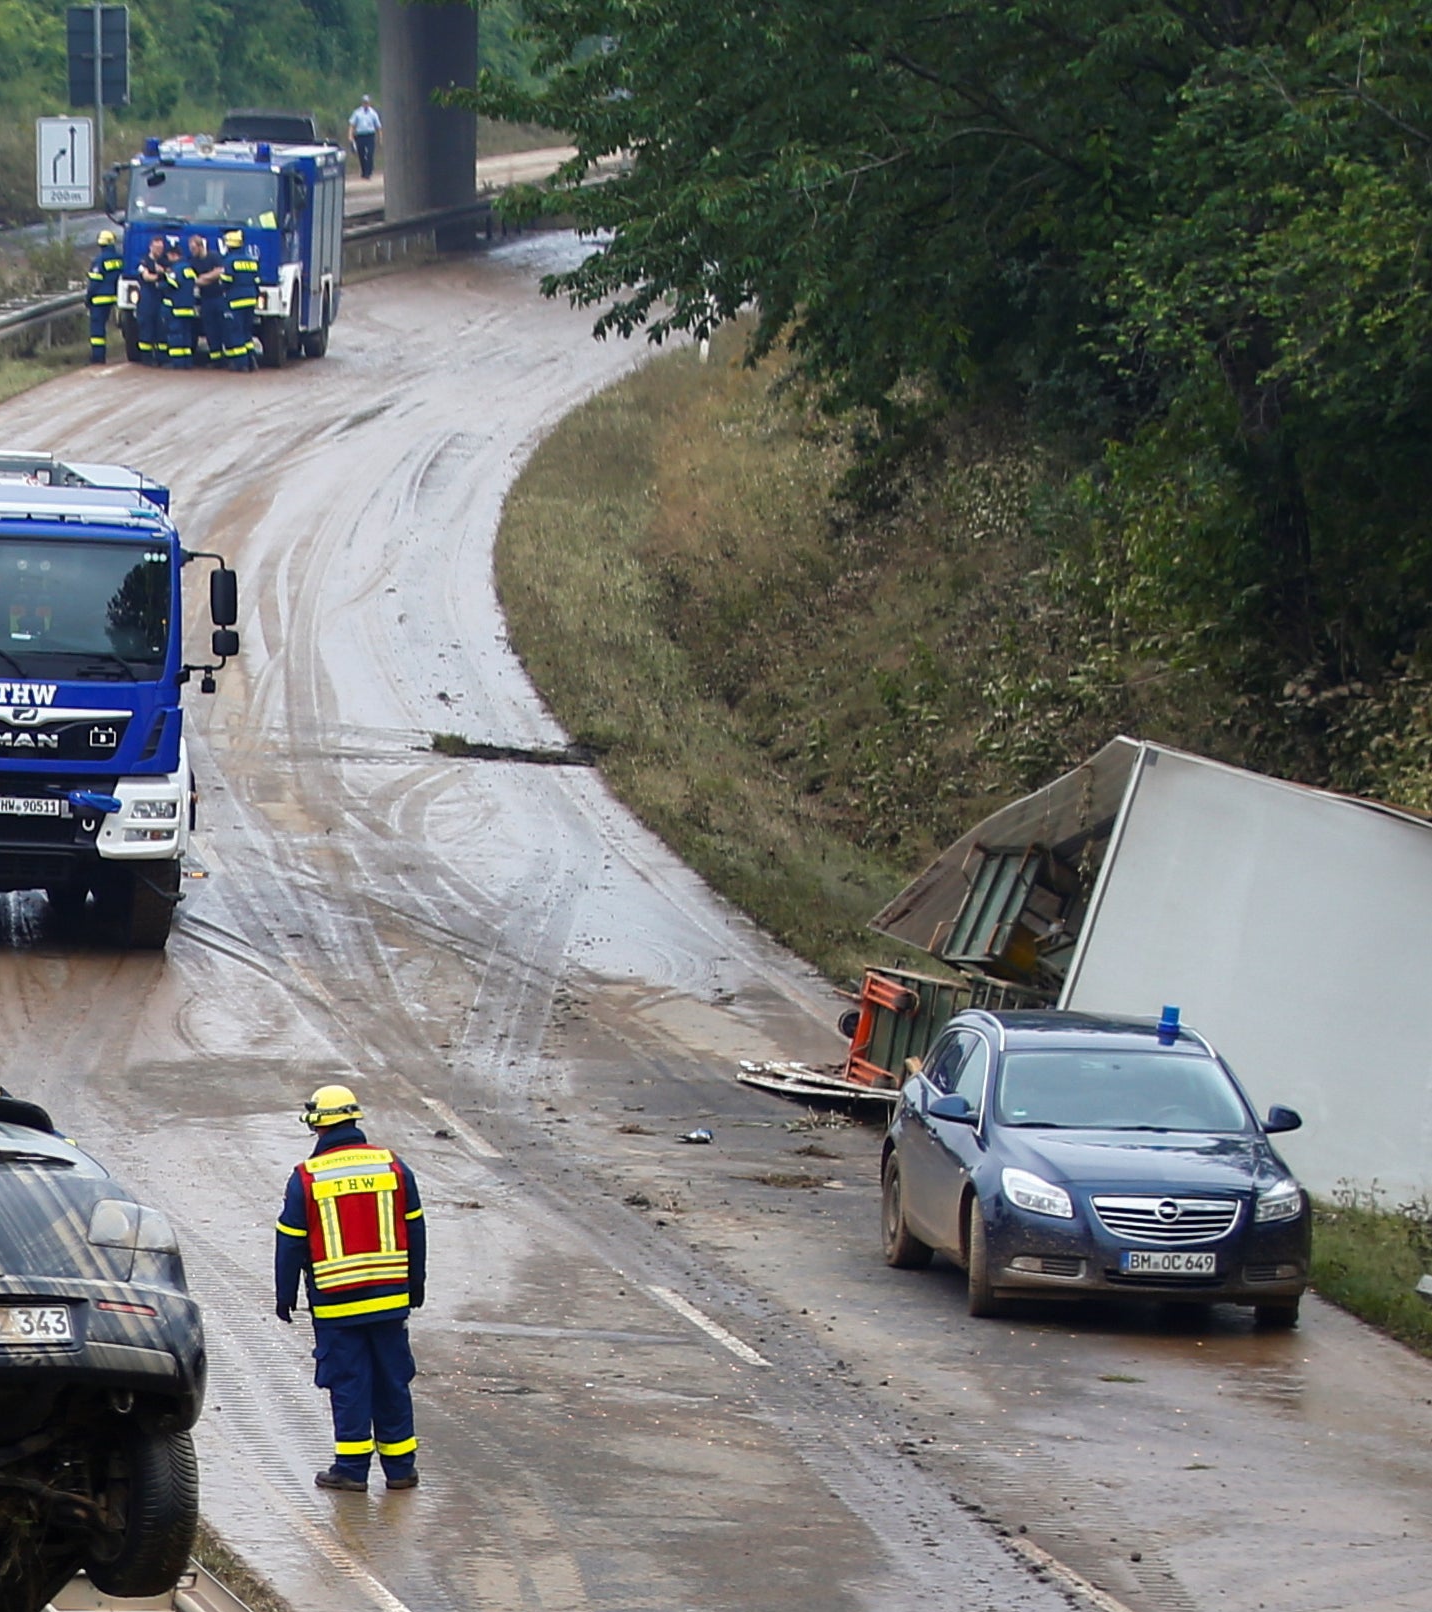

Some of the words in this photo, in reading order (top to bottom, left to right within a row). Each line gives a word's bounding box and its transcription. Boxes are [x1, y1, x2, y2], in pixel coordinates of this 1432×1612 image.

[22, 800, 56, 814] 90511
[334, 1177, 375, 1192] THW
[1130, 1254, 1151, 1269] BM
[1161, 1254, 1181, 1270] OC
[1185, 1255, 1214, 1271] 649
[19, 1310, 67, 1336] 343
